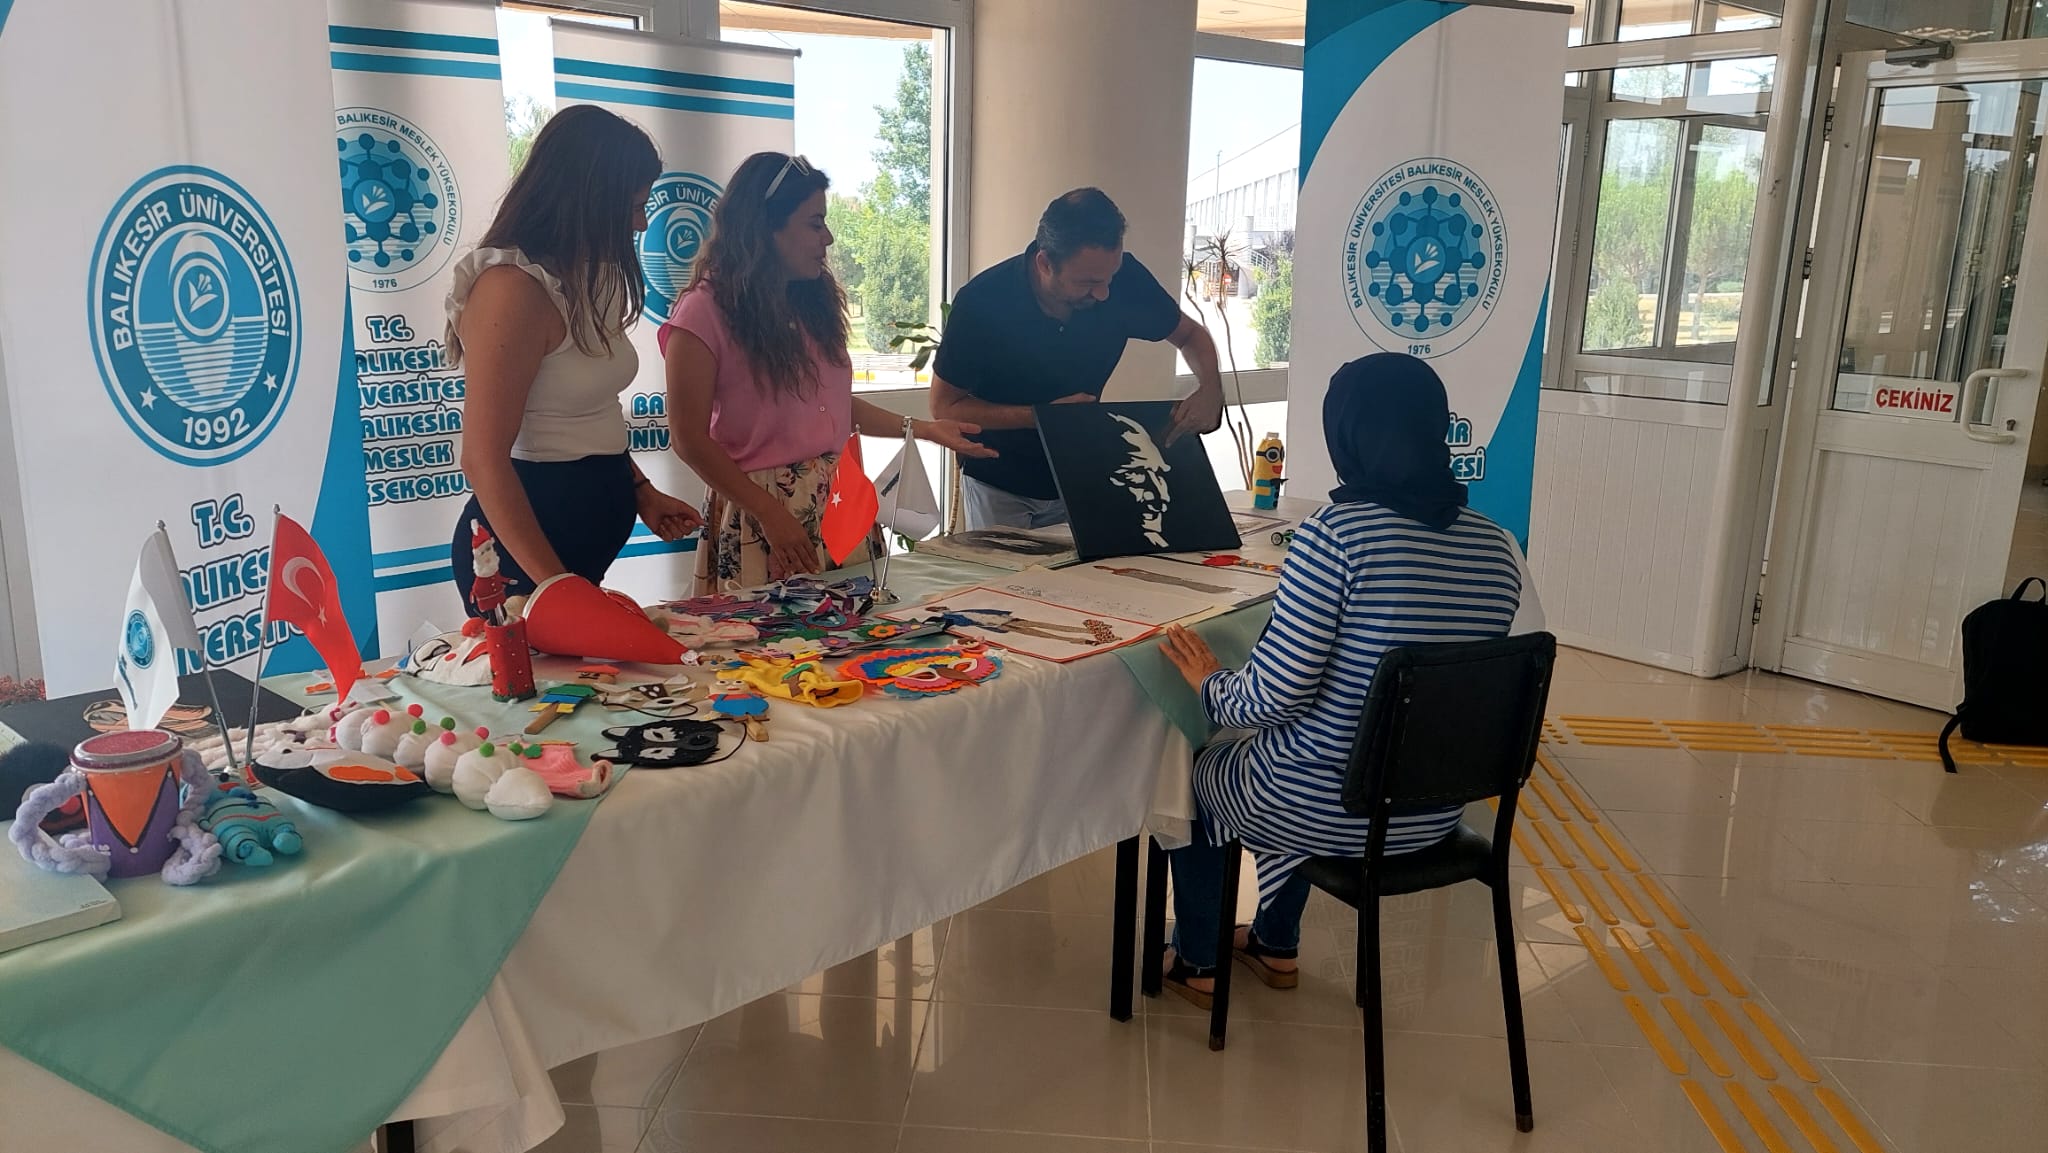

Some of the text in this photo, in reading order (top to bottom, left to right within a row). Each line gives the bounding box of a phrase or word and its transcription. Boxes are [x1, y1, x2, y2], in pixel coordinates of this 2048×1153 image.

[337, 113, 457, 246] BALIKESİR MESLEK YÜKSEKOKULU
[1347, 164, 1504, 310] BALIKESİR ÜNİVERSİTESİ BALIKESİR MESLEK YÜKSEKOKULU
[110, 188, 290, 351] BALIKESİR ÜNİVERSİTESİ
[372, 278, 398, 289] 1976
[367, 316, 414, 341] T.C.
[356, 341, 448, 374] ALIKESİ
[1407, 344, 1431, 355] 1976
[1876, 387, 1954, 413] ÇEKİNİZ
[182, 407, 250, 446] 1992
[361, 405, 463, 442] ALIKESİR
[364, 442, 453, 473] MESLEK
[193, 495, 254, 547] T.C.
